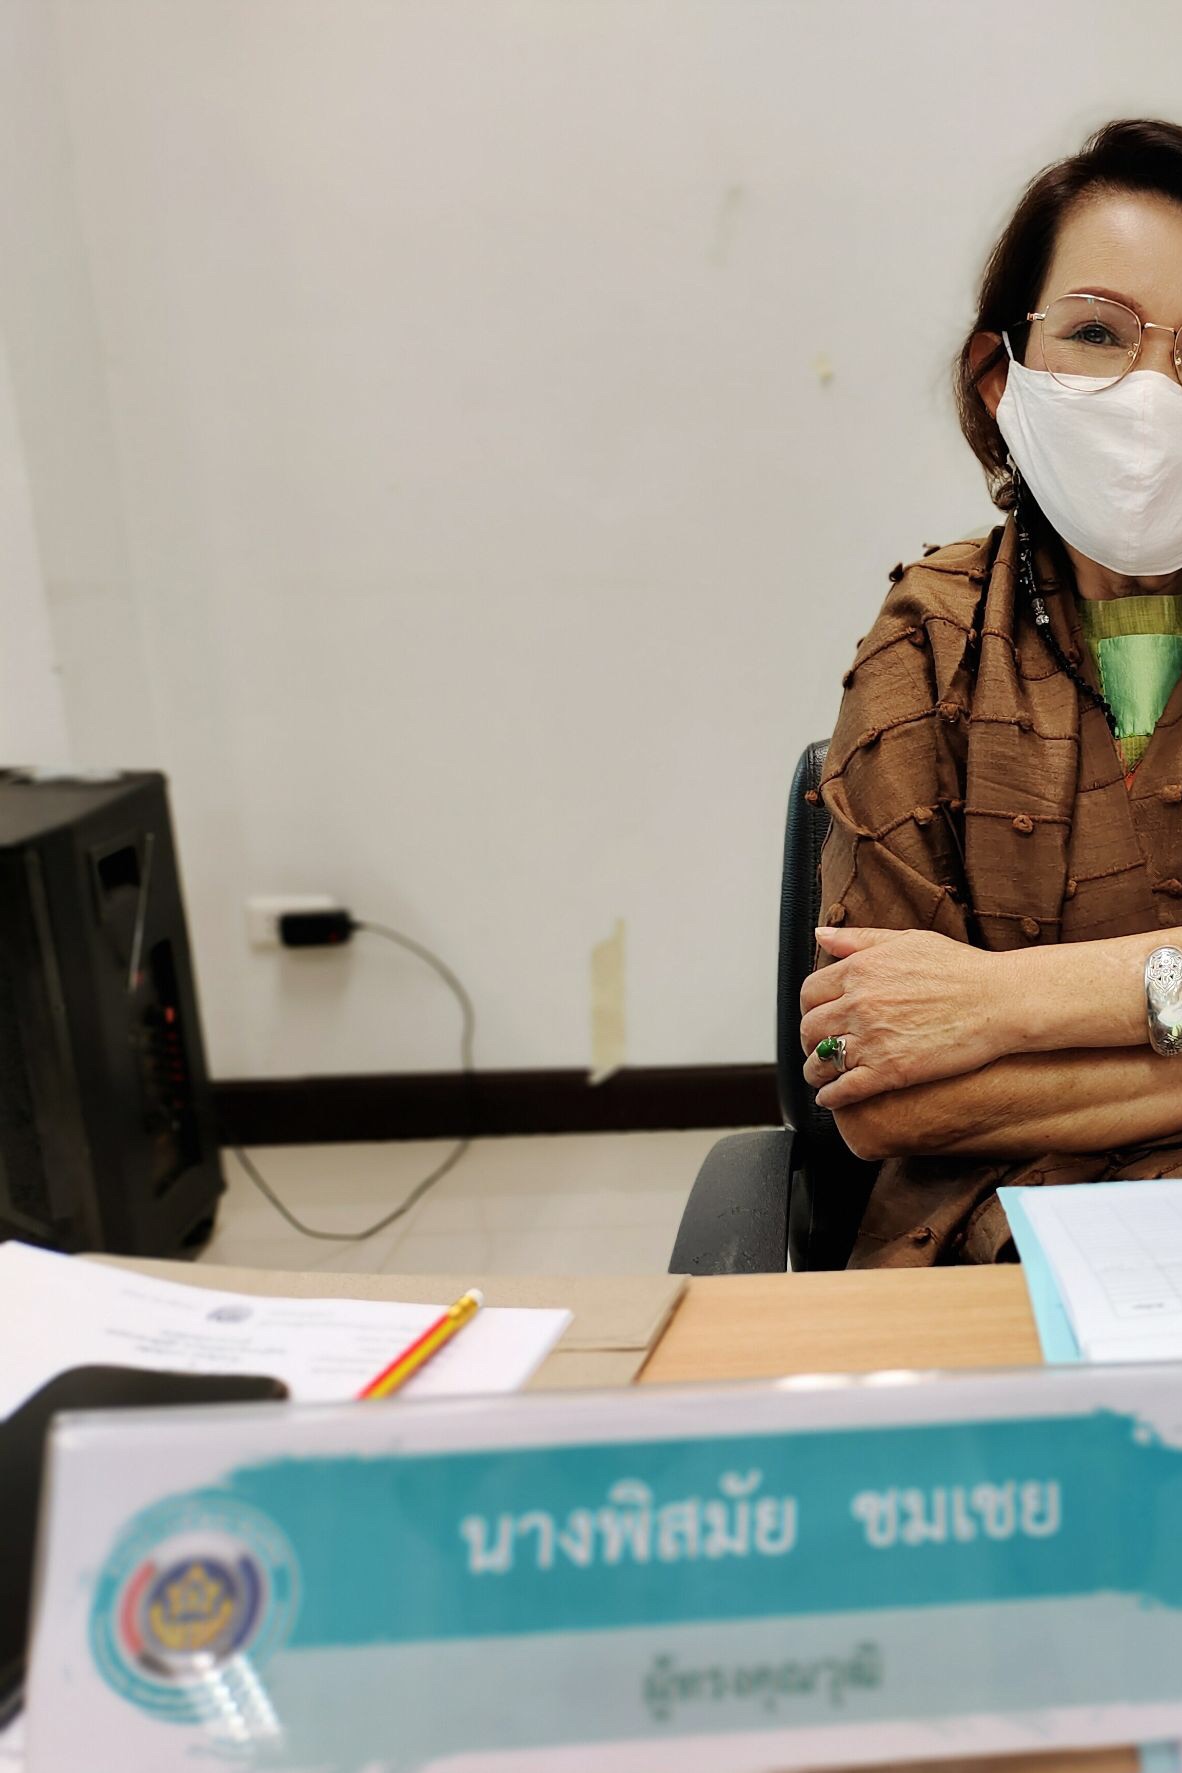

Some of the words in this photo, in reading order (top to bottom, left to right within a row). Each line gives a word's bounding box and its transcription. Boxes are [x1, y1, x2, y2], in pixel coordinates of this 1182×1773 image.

[460, 1468, 797, 1573] นางพิสมัย
[851, 1480, 1061, 1548] ชมเชย
